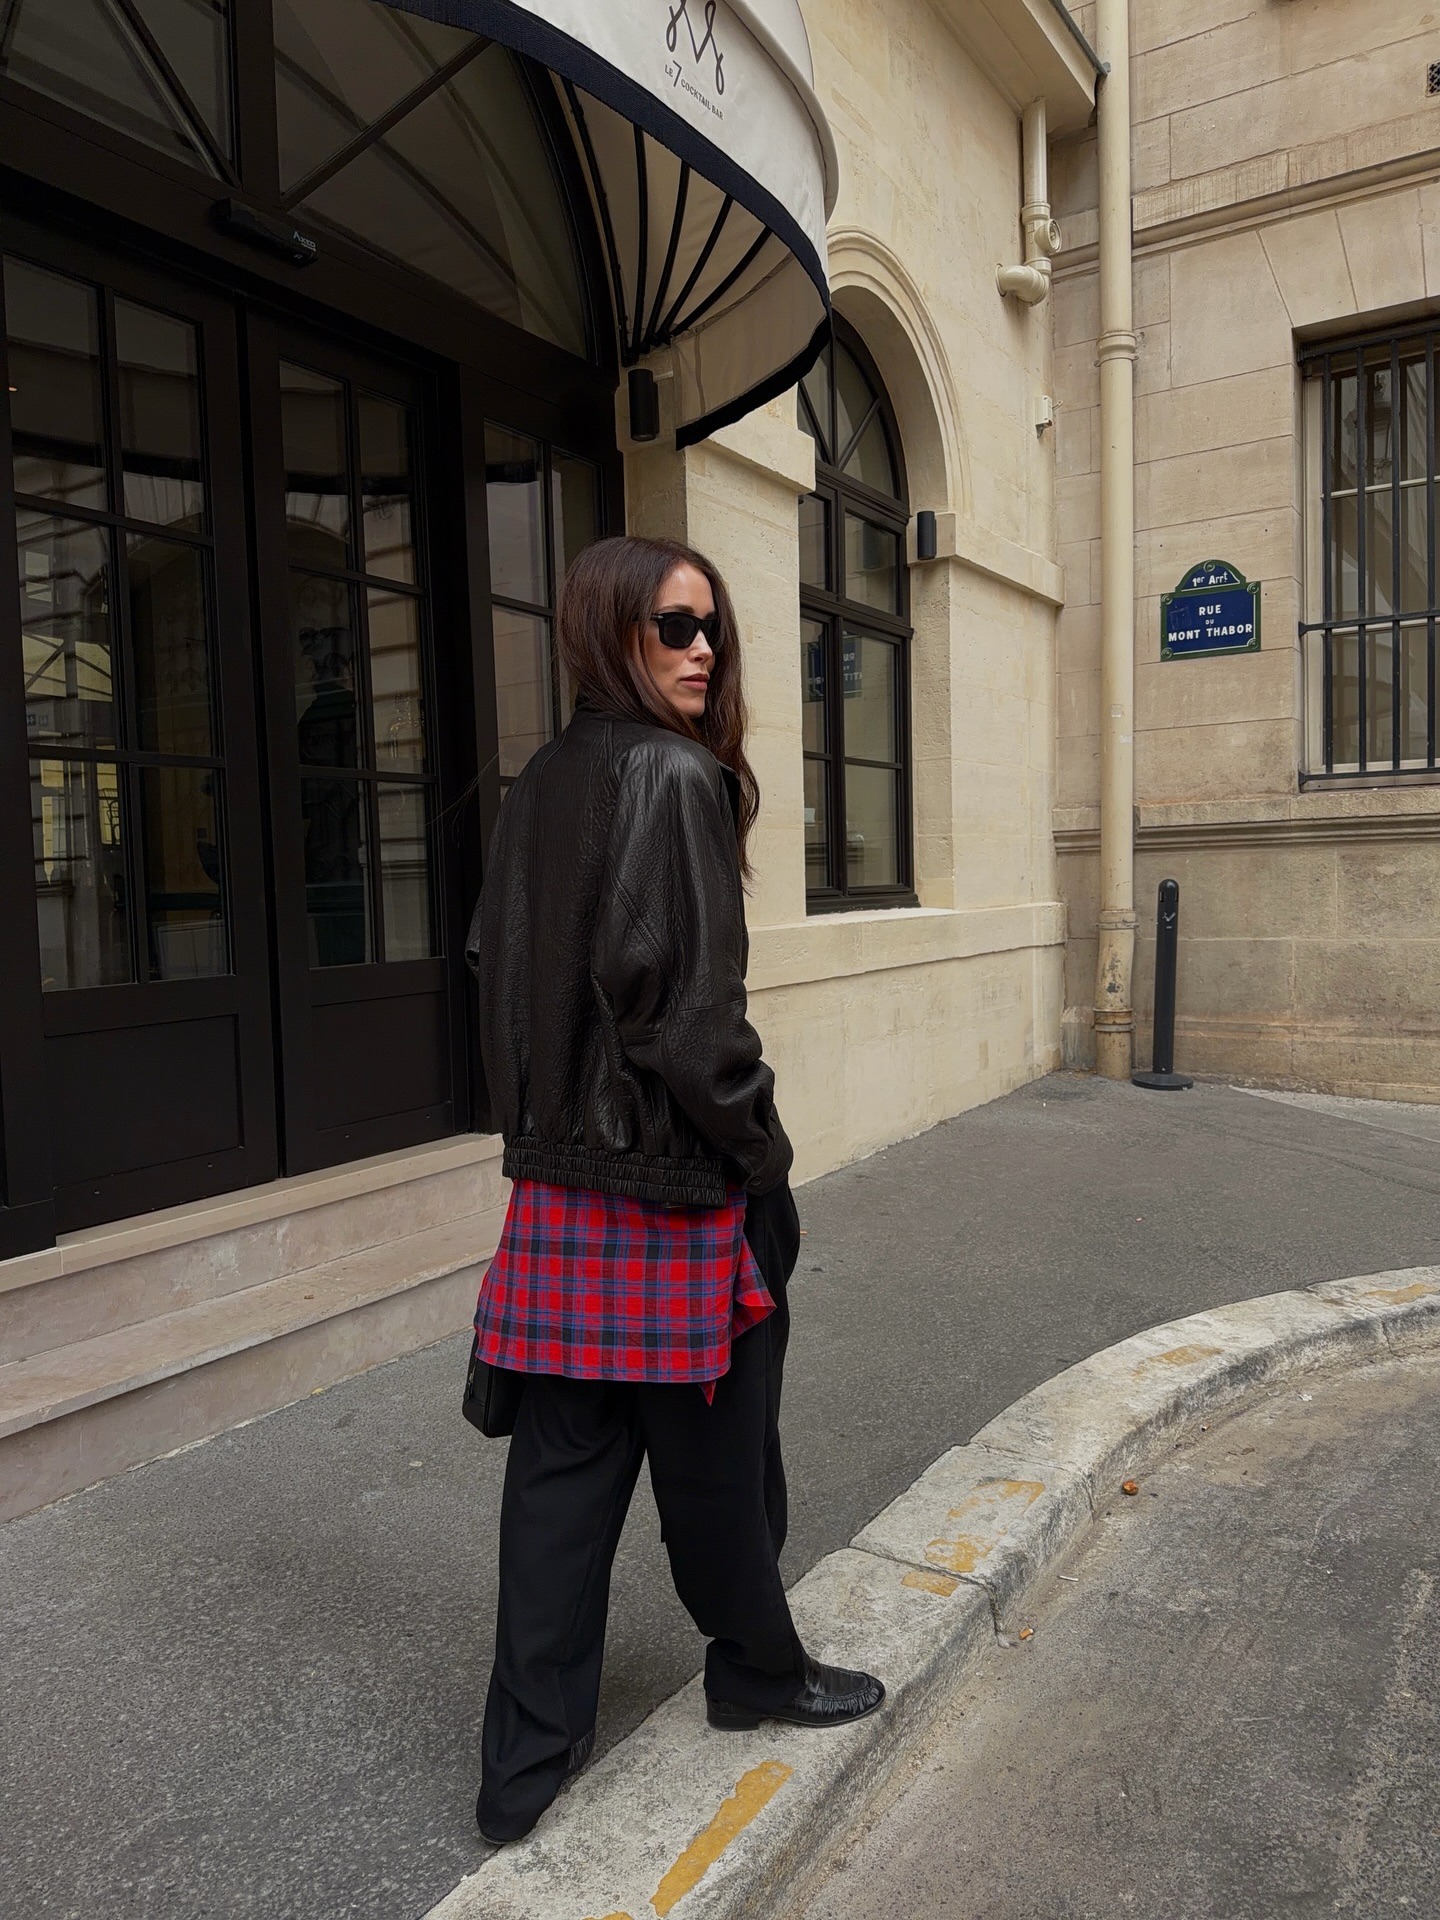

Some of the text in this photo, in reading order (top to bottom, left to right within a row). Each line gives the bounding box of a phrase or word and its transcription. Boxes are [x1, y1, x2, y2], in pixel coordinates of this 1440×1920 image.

[664, 60, 723, 120] LE 7 COCKTAIL BAR
[1192, 577, 1205, 587] 1er
[1199, 605, 1221, 616] RUE
[1168, 624, 1252, 642] MONT THABOR
